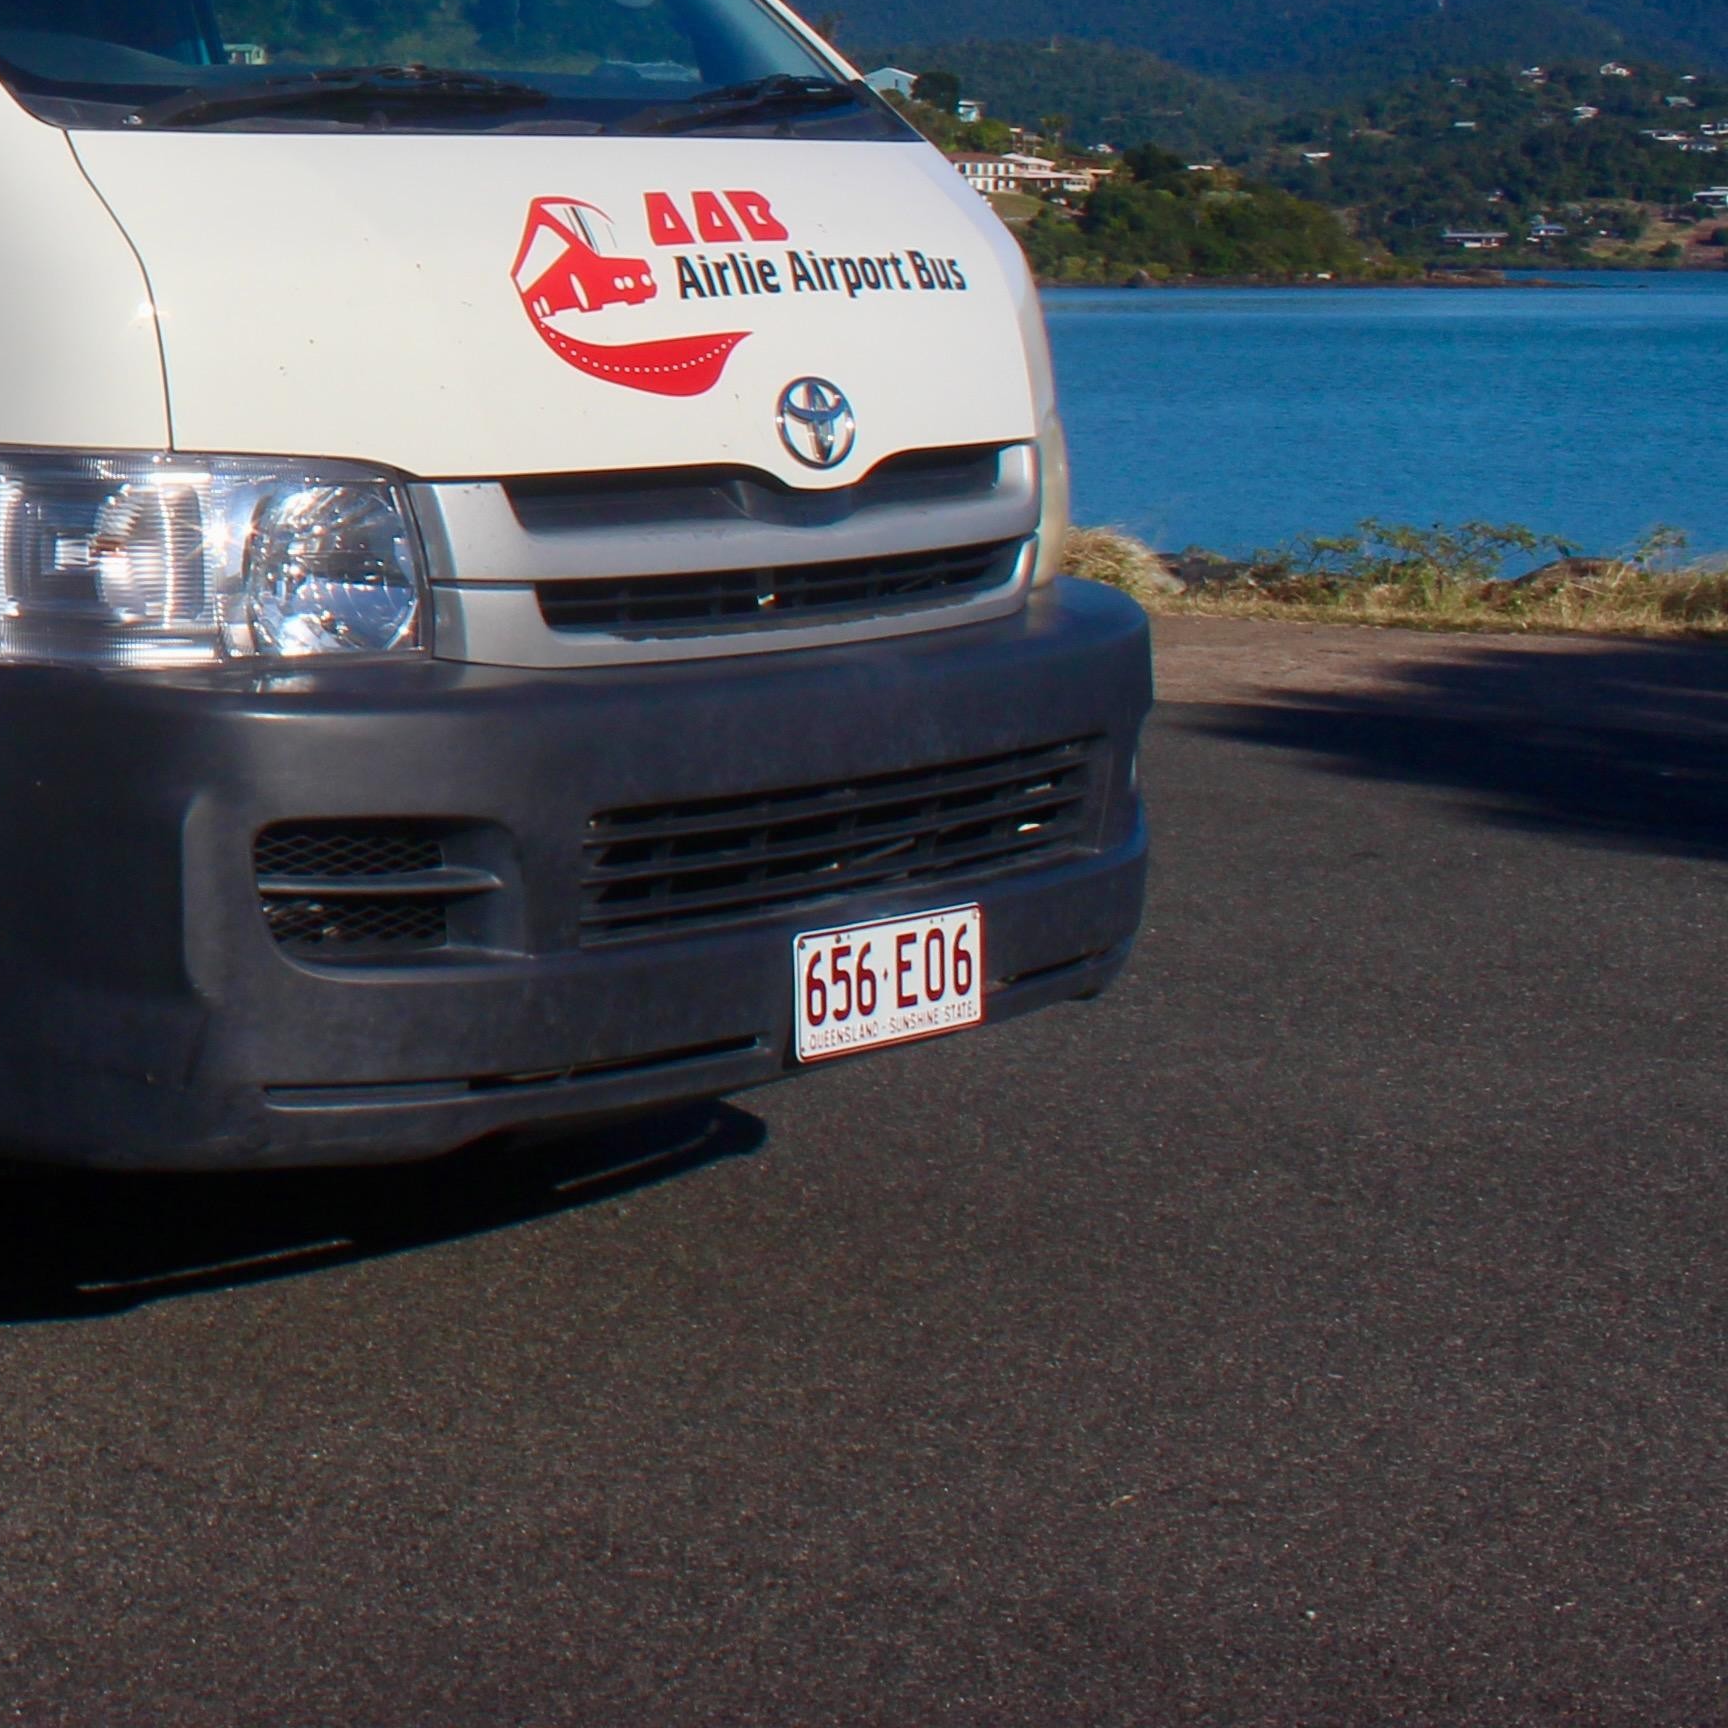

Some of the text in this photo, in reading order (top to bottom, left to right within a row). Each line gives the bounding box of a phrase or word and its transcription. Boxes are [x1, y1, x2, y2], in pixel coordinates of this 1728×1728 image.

[644, 191, 788, 246] AAB
[674, 251, 966, 300] Airlie Airport Bus
[810, 1021, 879, 1050] QUEENSLAND
[889, 1007, 939, 1034] SUNSHINE
[945, 1001, 973, 1022] STATE
